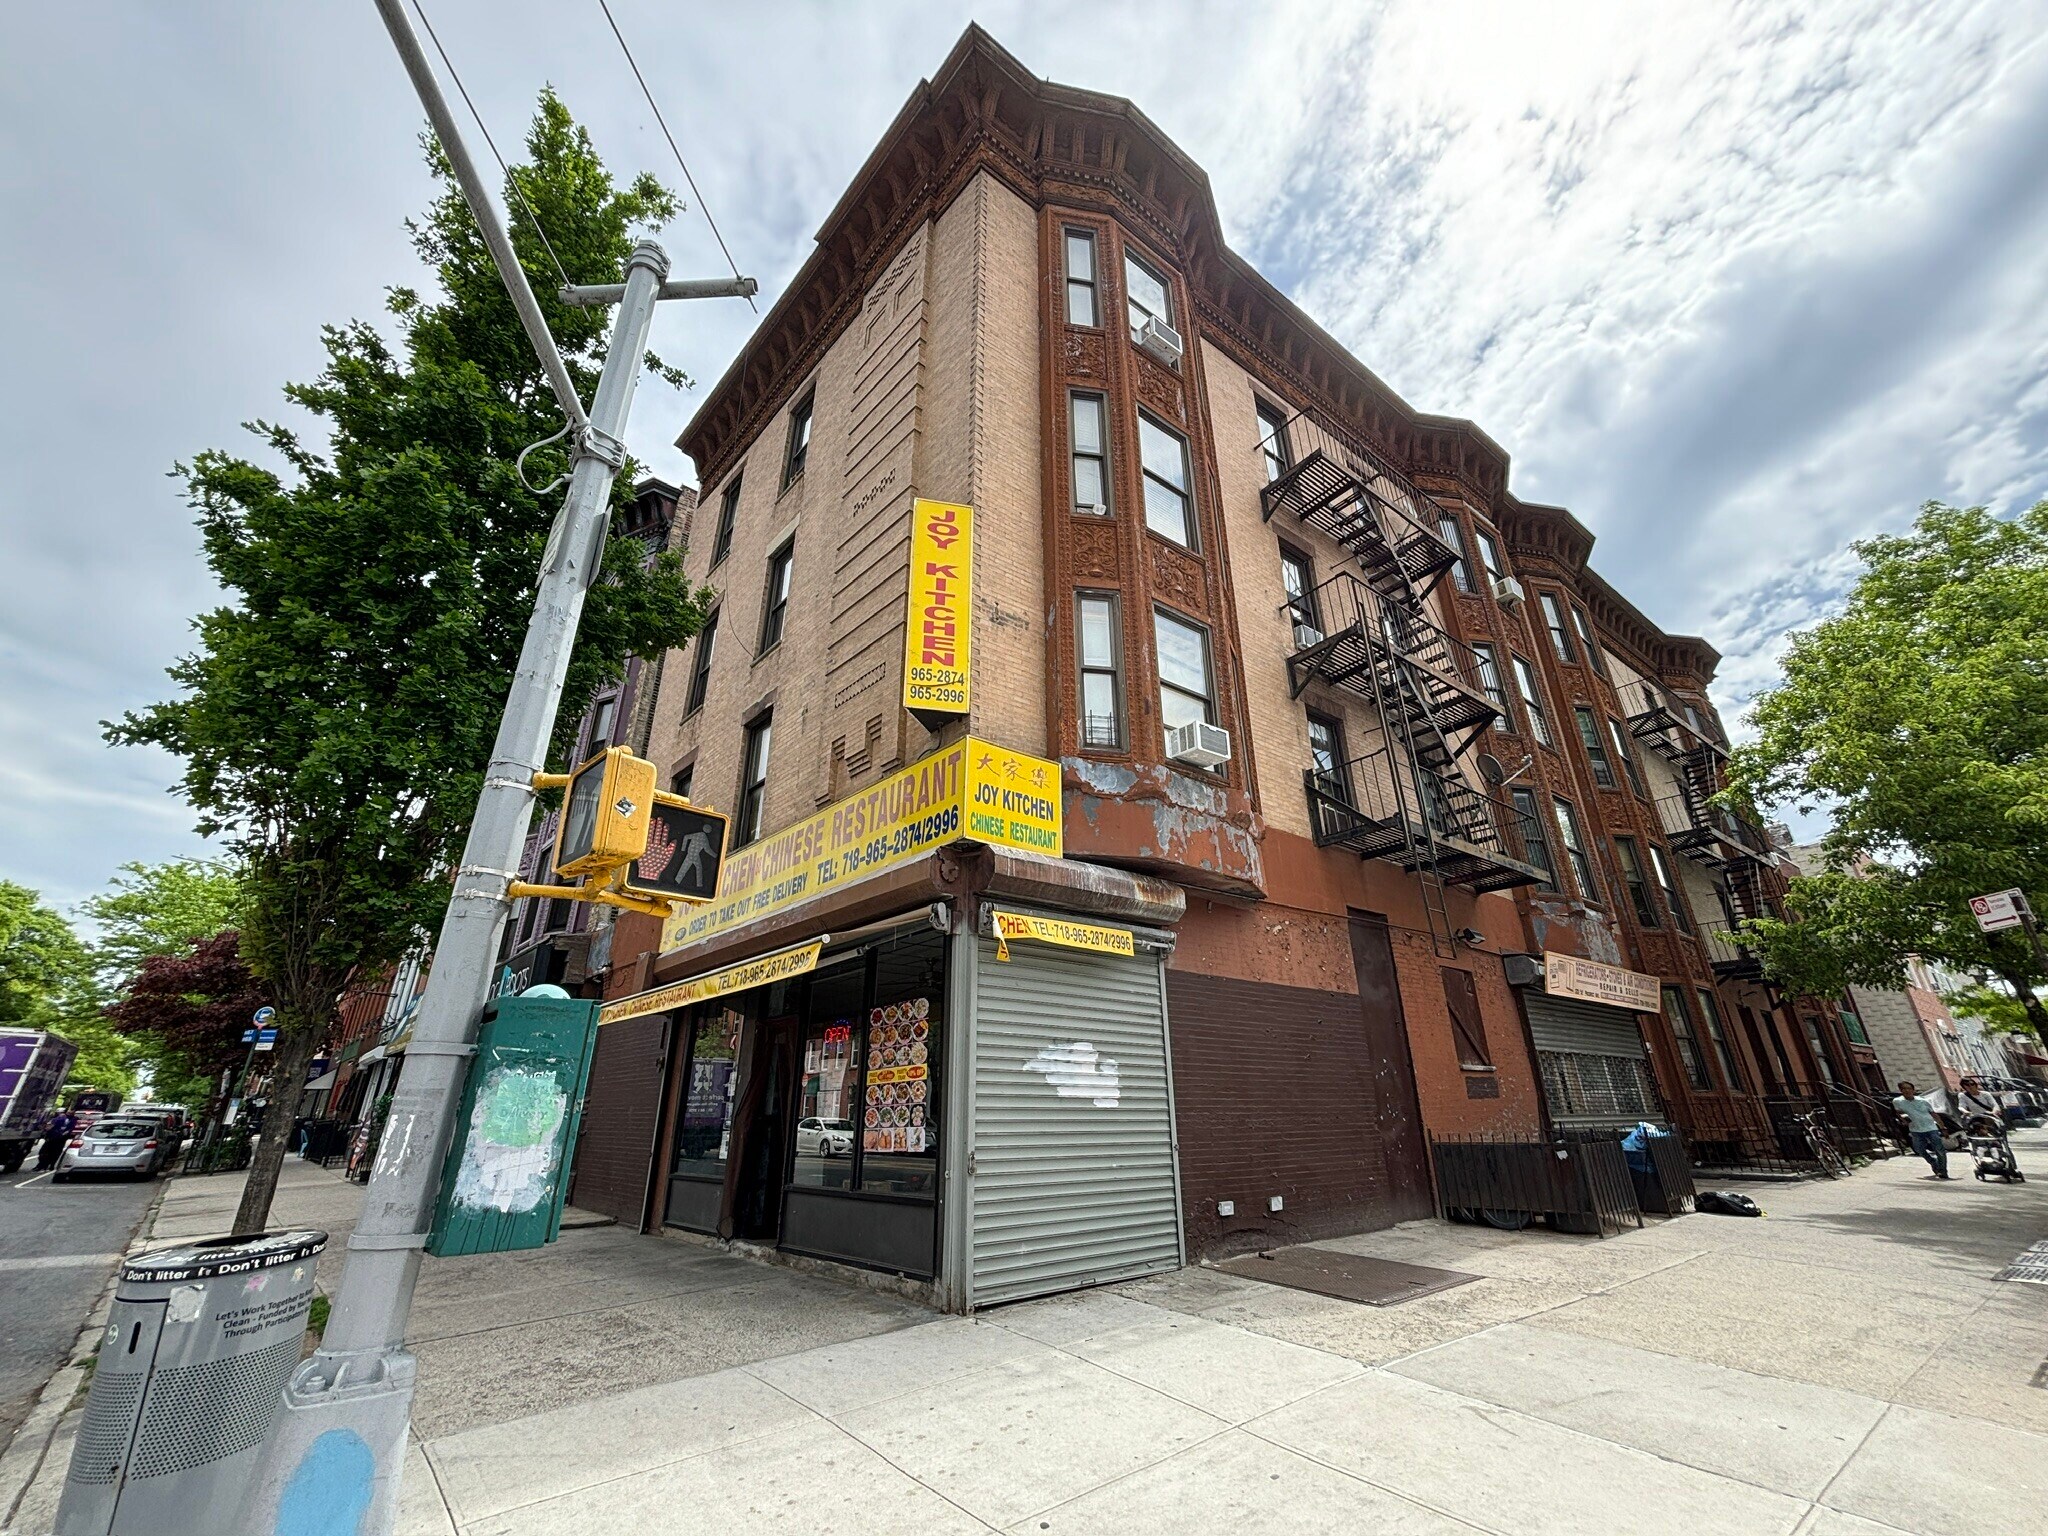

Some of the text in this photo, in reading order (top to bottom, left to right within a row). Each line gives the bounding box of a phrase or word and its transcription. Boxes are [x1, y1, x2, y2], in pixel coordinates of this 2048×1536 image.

[922, 510, 960, 667] JOY KITCHEN
[911, 667, 965, 687] 965-2874
[909, 686, 965, 704] 965-2996
[974, 781, 1054, 822] JOY KITCHEN
[761, 818, 826, 882] CHINESE
[831, 749, 962, 851] RESTAURANT
[970, 811, 1057, 850] CHINESE RESTAURANT
[709, 910, 717, 928] TO
[719, 902, 736, 924] TAKE
[737, 896, 752, 917] OUT
[752, 888, 771, 911] FREE
[772, 871, 809, 903] DELIVERY
[817, 858, 838, 886] TEL:
[842, 804, 959, 876] 718-965-2874/2996
[653, 984, 697, 1010] RESTAURANT
[825, 1026, 852, 1044] OPEN
[127, 1270, 153, 1280] Don't
[155, 1270, 191, 1281] litter
[218, 1259, 261, 1274] Don't
[265, 1252, 297, 1266] litter
[312, 1242, 326, 1254] Don
[216, 1310, 239, 1321] Let's
[241, 1305, 266, 1316] Work
[268, 1294, 299, 1310] Together
[223, 1318, 250, 1329] Clean
[258, 1306, 288, 1321] Funded
[225, 1323, 263, 1339] Through
